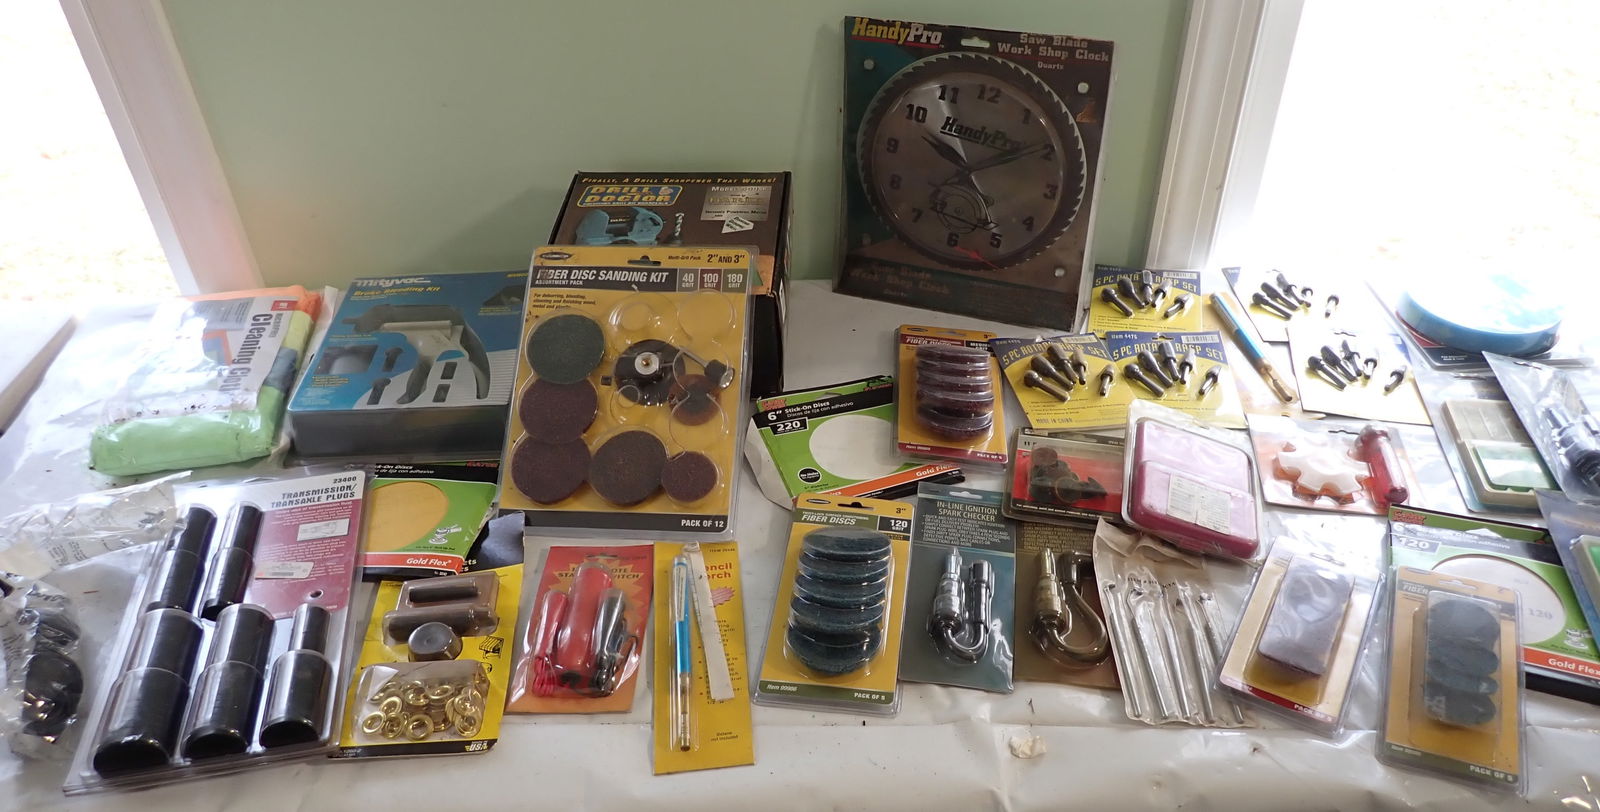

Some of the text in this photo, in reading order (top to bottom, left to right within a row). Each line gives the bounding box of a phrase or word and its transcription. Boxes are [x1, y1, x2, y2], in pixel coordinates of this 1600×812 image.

[852, 17, 943, 45] HandyPro
[1019, 33, 1089, 48] Saw Blade
[997, 43, 1109, 62] Work Shop Clock
[1037, 61, 1064, 70] Quartz
[938, 84, 960, 104] 11
[976, 83, 1001, 104] 12
[905, 103, 928, 124] 10
[1021, 108, 1032, 125] 1
[886, 136, 899, 153] 9
[889, 174, 902, 190] 8
[584, 192, 672, 203] DOCTOR
[1043, 183, 1057, 200] 3
[911, 207, 924, 223] 7
[1021, 216, 1035, 231] 4
[946, 233, 960, 247] 6
[989, 233, 1003, 248] 5
[718, 256, 733, 264] AND
[570, 270, 597, 281] DISC
[598, 270, 648, 283] SANDING
[649, 272, 669, 283] KIT
[682, 273, 694, 283] 40
[703, 273, 718, 283] 100
[727, 273, 743, 283] 180
[1095, 275, 1198, 293] 5 PC SET
[231, 313, 274, 365] Cleaning
[1002, 355, 1010, 366] 5
[1008, 349, 1021, 360] PC
[1088, 346, 1108, 358] SET
[1112, 350, 1120, 360] 5
[1120, 346, 1132, 355] PC
[1206, 347, 1224, 361] SET
[784, 404, 812, 414] Stick-On
[812, 401, 830, 409] Discs
[776, 420, 801, 432] 220
[915, 467, 935, 477] Gold
[333, 476, 357, 484] 23400
[282, 484, 357, 499] TRANSMISSION/
[270, 492, 355, 508] TRANSAXLE PLUGS
[936, 500, 998, 515] IN-LINE IGNITION
[801, 514, 857, 526] FIBER DISCS
[938, 508, 996, 522] SPARK CHECKER
[681, 519, 724, 528] PACK OF 12
[889, 519, 908, 528] 120
[1398, 537, 1430, 549] 120
[406, 557, 428, 565] Gold
[1528, 607, 1554, 620] 120
[1547, 658, 1575, 670] Gold
[1469, 765, 1491, 776] PACK
[1493, 771, 1505, 779] OF
